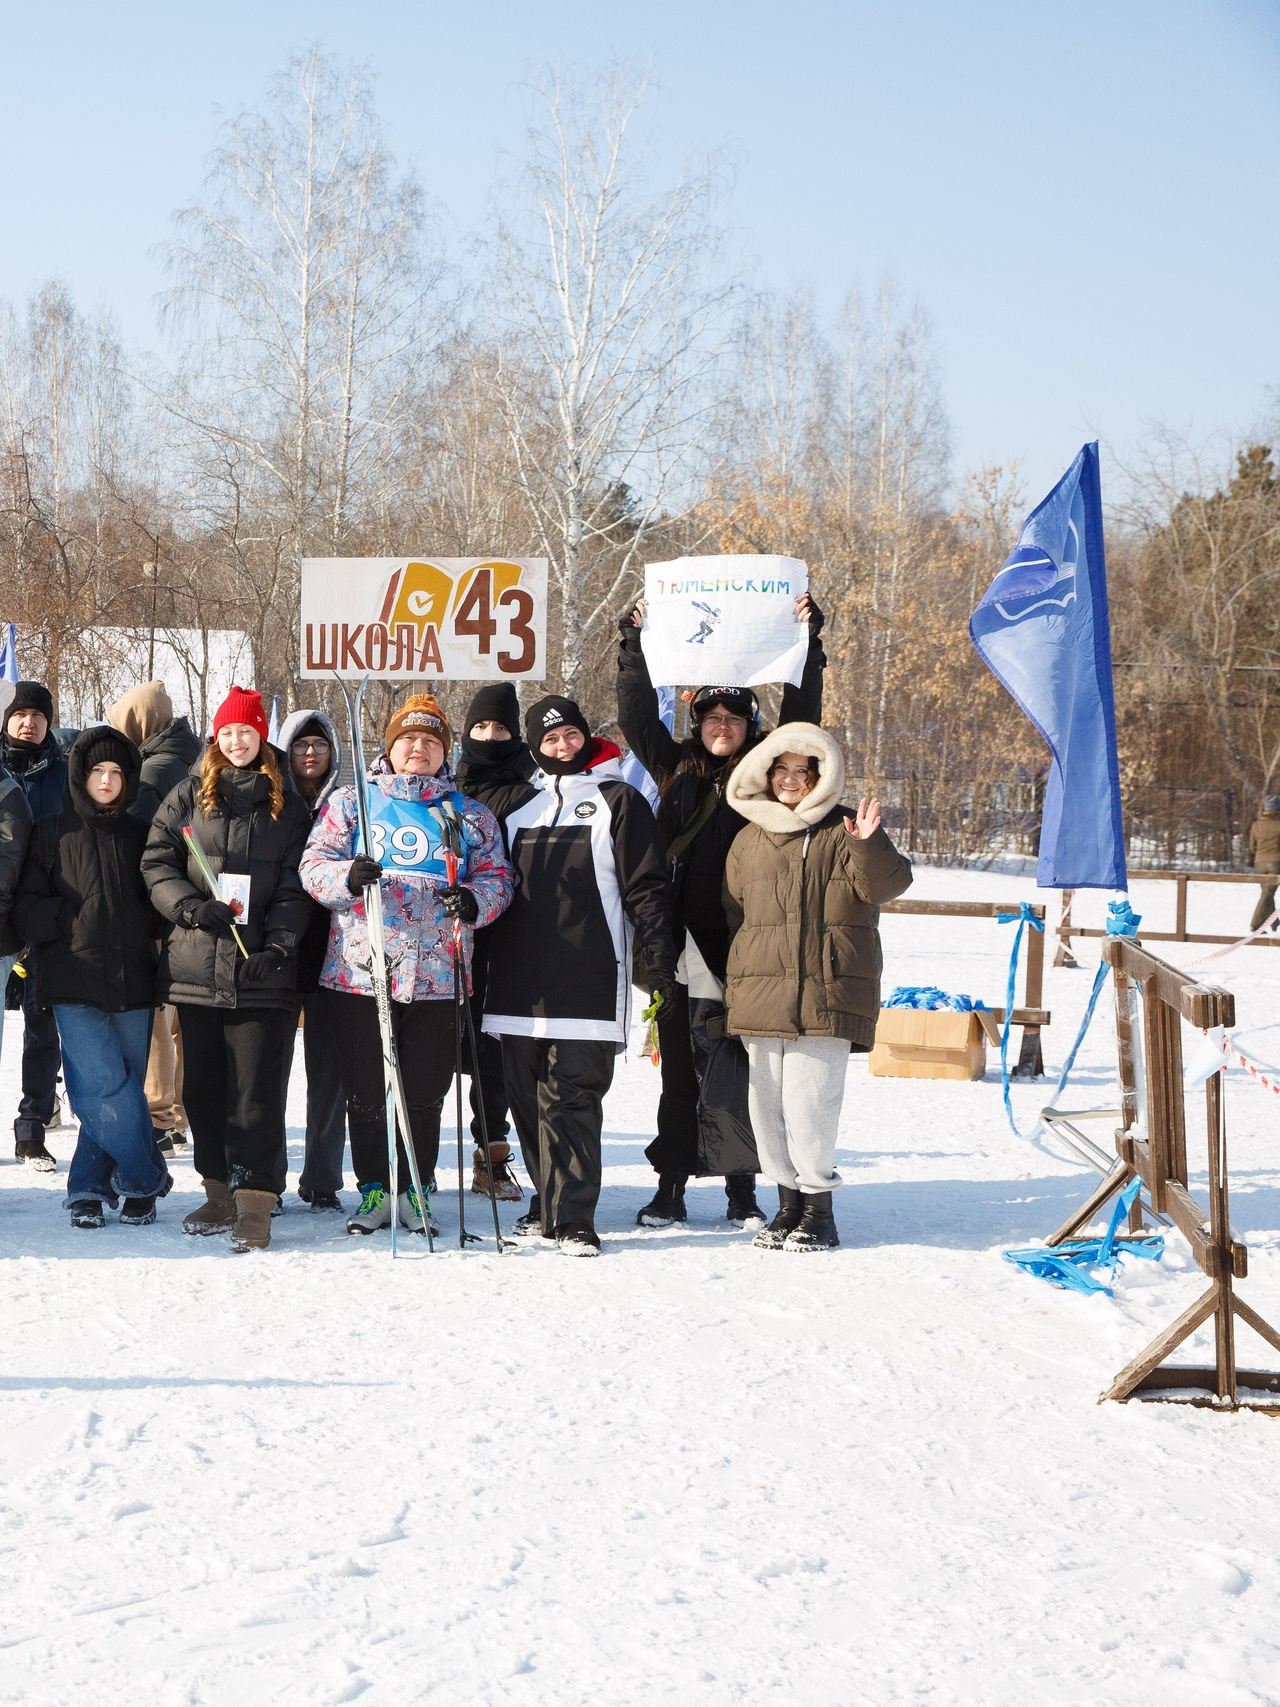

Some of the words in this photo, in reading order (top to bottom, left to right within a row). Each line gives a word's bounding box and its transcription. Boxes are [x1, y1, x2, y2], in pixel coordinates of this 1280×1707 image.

[306, 623, 444, 673] ШКОЛА
[455, 569, 537, 674] 43
[543, 717, 564, 727] adidas
